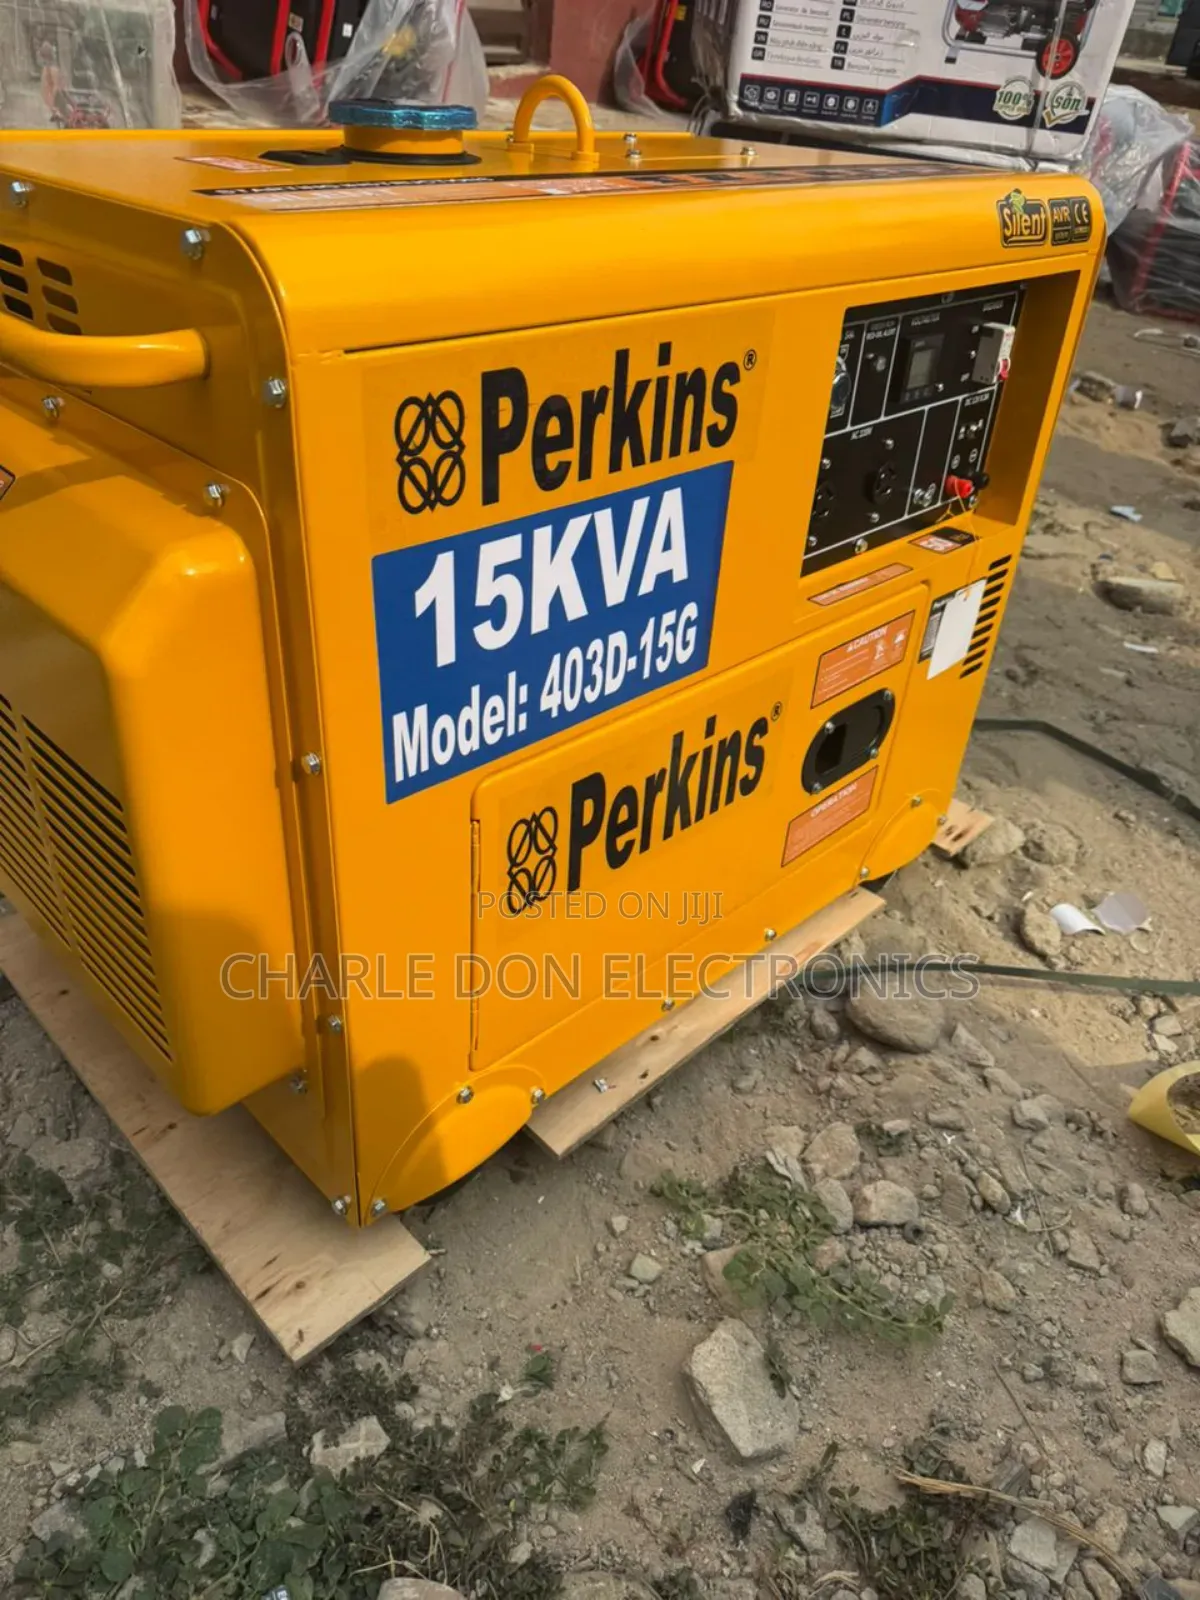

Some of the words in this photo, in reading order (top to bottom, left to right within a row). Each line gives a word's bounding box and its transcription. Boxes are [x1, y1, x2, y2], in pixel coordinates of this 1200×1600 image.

[997, 90, 1032, 109] 100%
[1002, 205, 1046, 237] Silent
[481, 341, 741, 506] Perkins
[415, 486, 689, 668] 15KVA
[392, 671, 528, 783] Model:
[540, 601, 698, 719] 403D-15G
[567, 714, 769, 896] Perkins
